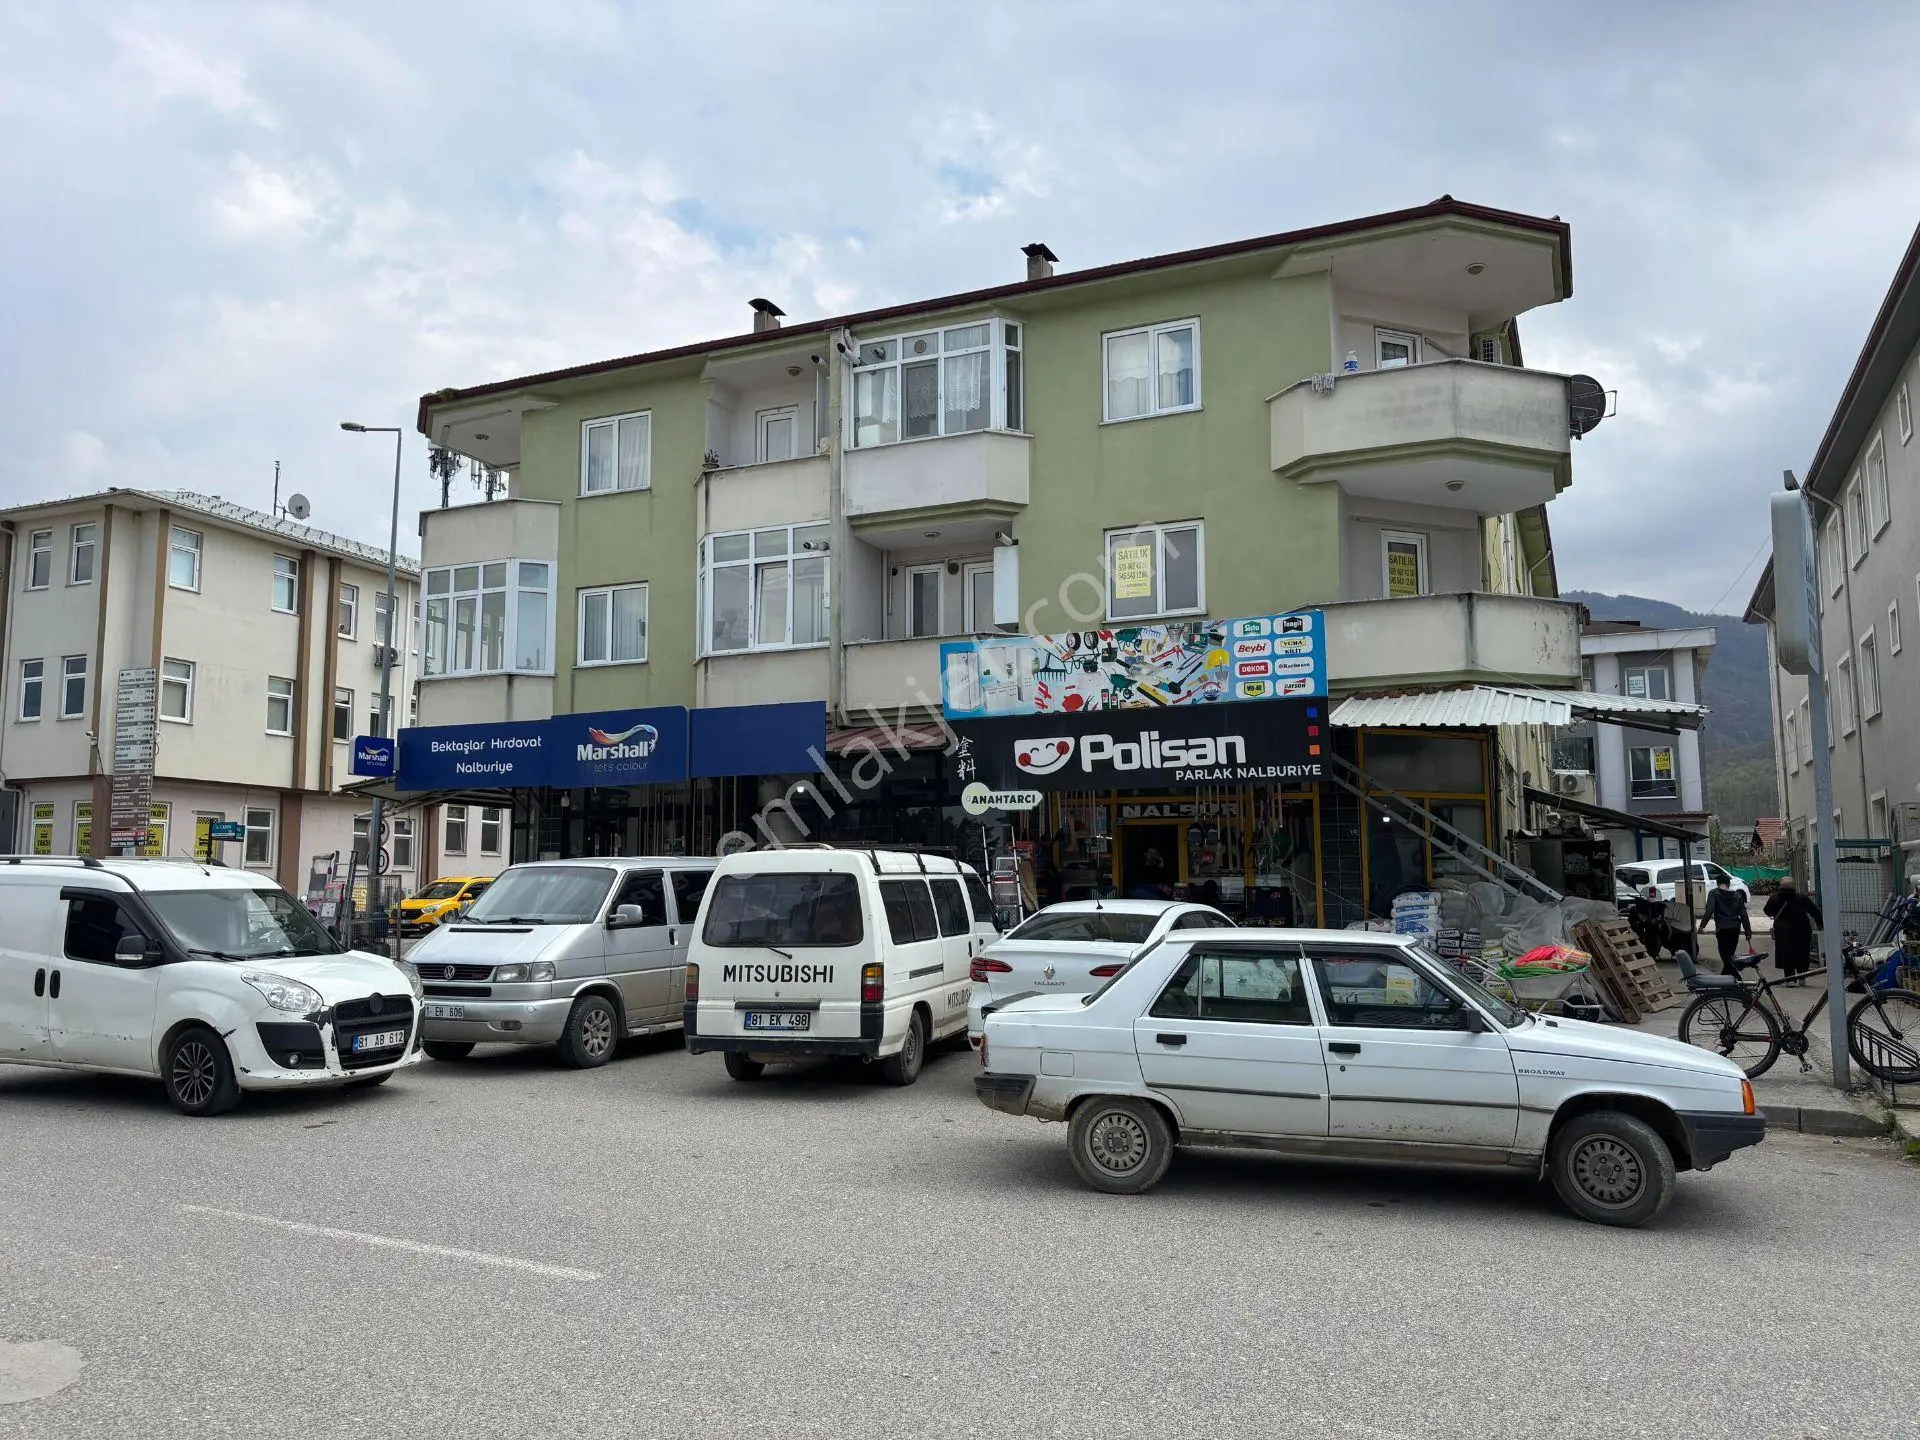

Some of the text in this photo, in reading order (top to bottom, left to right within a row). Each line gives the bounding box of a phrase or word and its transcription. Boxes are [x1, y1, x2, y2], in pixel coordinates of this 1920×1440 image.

[1118, 549, 1148, 561] SATILIK
[1389, 555, 1415, 567] SATILIK
[1244, 624, 1260, 632] Sista
[1238, 643, 1267, 653] Beybi
[431, 736, 542, 755] Bektaşlar Hırdavat
[577, 741, 649, 761] Marshall
[1079, 731, 1247, 773] Polisan
[358, 751, 388, 762] Marshall
[456, 761, 514, 775] Nalburiye
[1175, 768, 1233, 781] PARLAK
[971, 794, 1037, 805] ANAHTARCI
[722, 964, 835, 983] MITSUBISHI
[751, 1014, 808, 1027] 81 EK 498
[358, 1031, 404, 1048] 81 AB 612
[1518, 1068, 1566, 1076] BROADWAY
